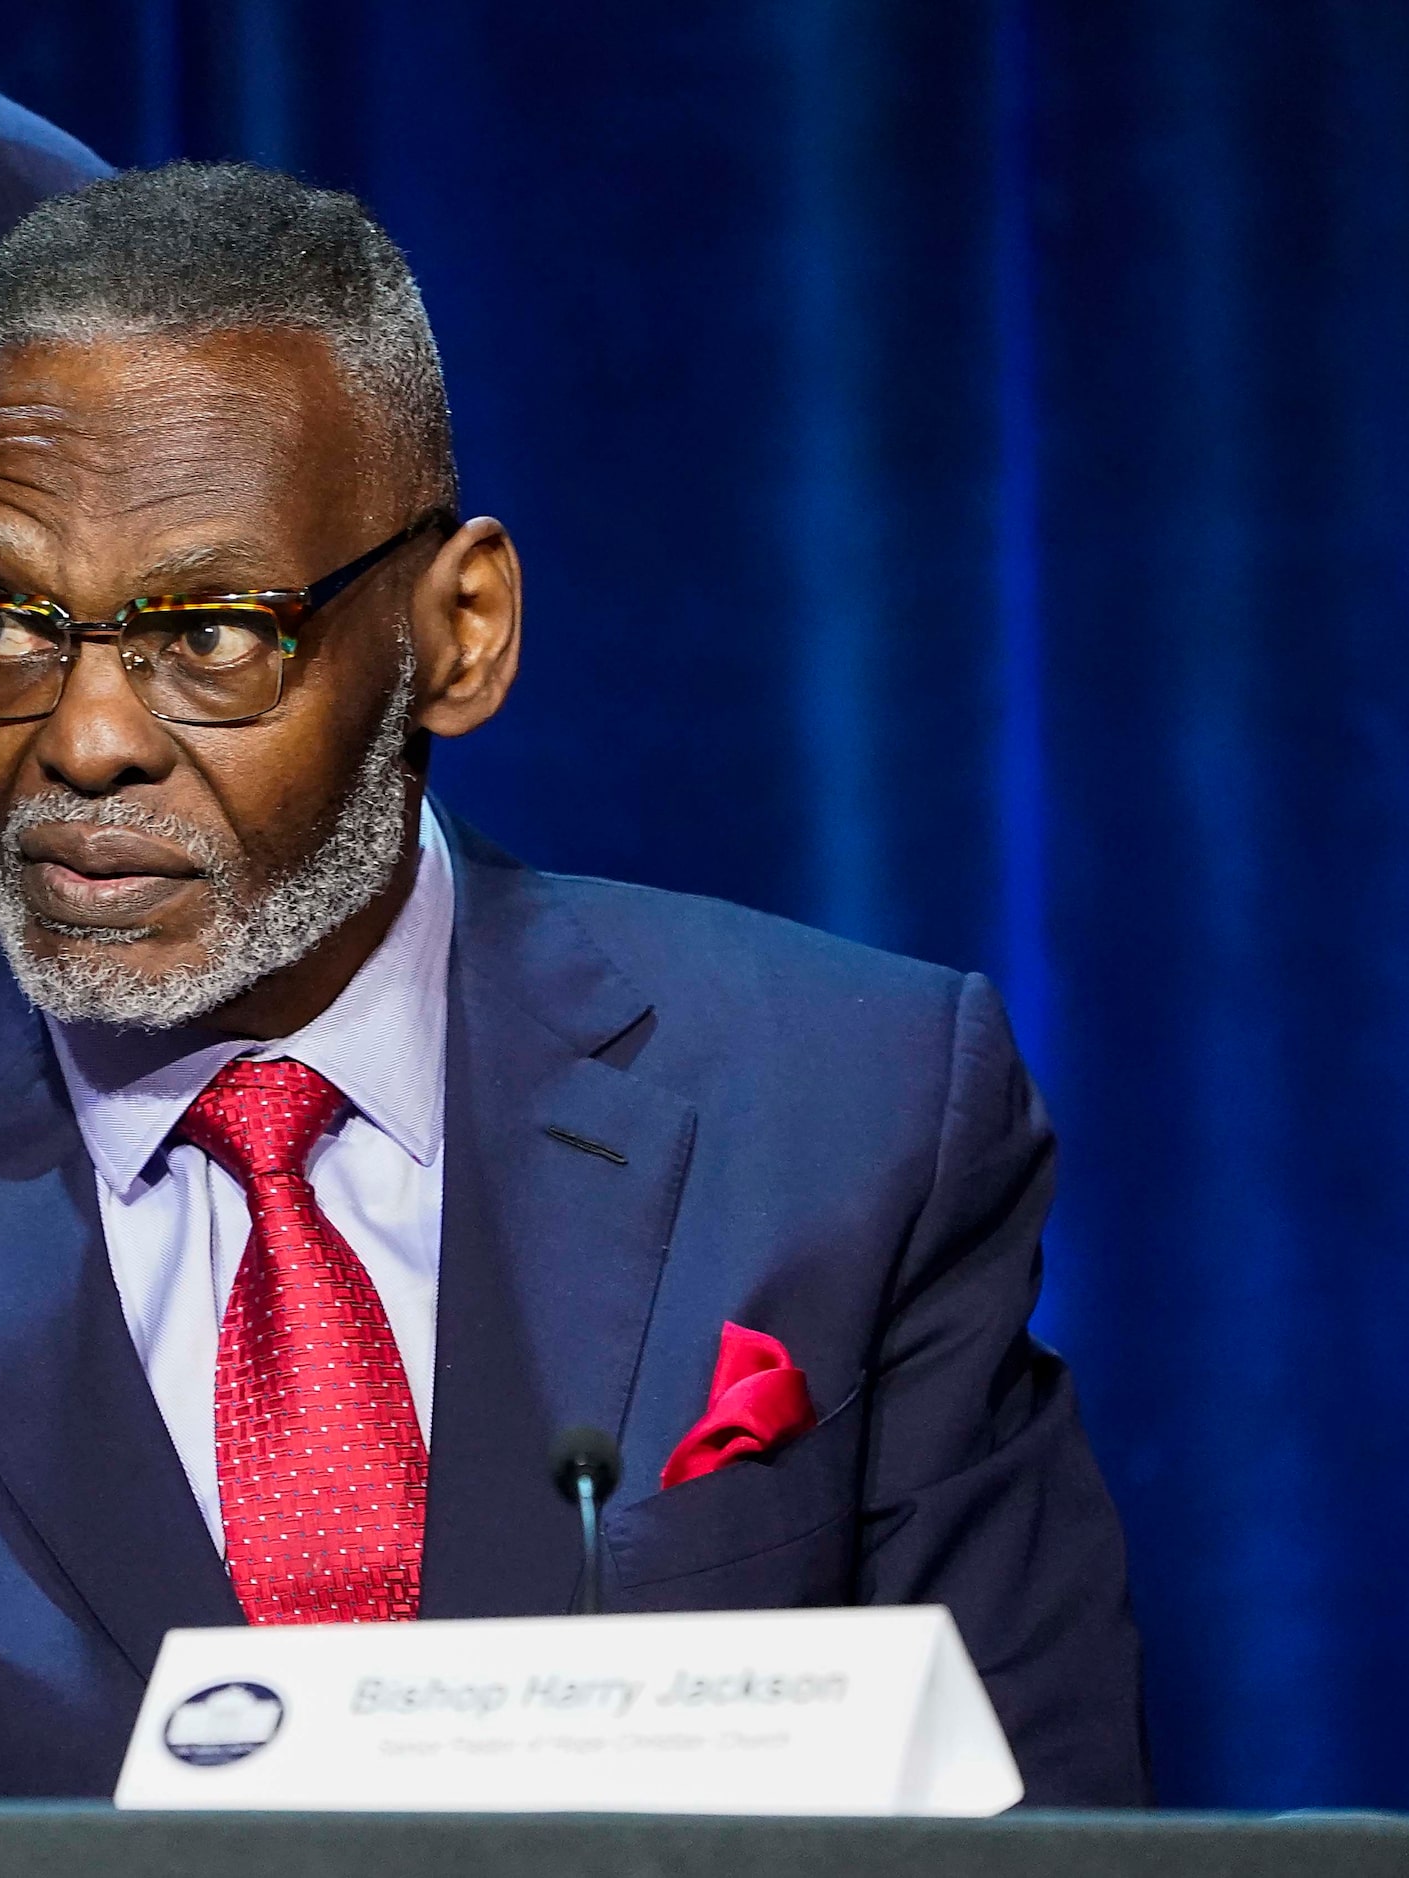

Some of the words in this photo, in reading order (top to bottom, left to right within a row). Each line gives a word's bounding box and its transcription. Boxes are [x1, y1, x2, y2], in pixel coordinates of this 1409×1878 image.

[349, 1676, 510, 1719] Bishop
[520, 1673, 647, 1718] Harry
[655, 1668, 850, 1707] Jackson
